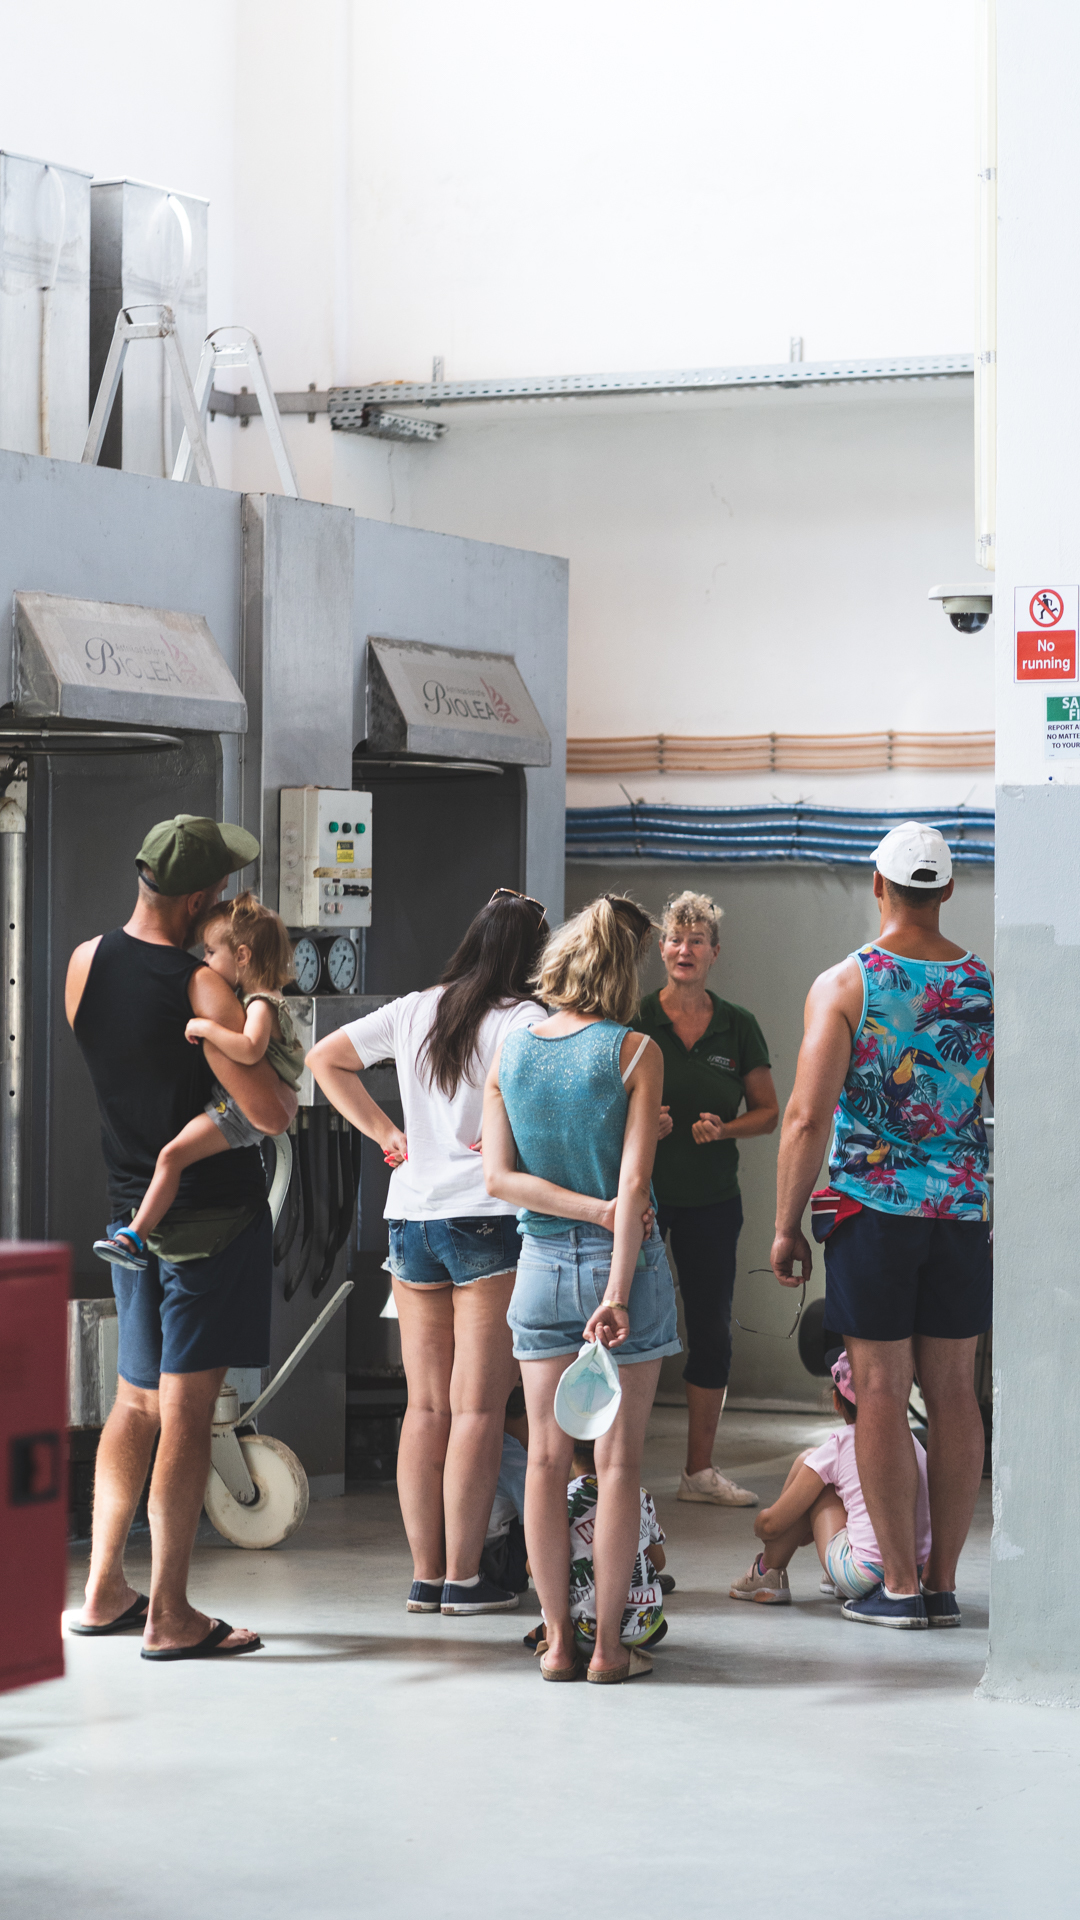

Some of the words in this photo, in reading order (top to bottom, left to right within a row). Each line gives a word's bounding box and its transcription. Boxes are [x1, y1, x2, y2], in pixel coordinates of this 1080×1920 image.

[1037, 639, 1055, 652] No
[85, 637, 182, 683] BIOLEA
[1022, 656, 1070, 671] running
[423, 680, 499, 721] BIOLEA
[1062, 696, 1080, 709] SA
[1069, 709, 1080, 721] FI
